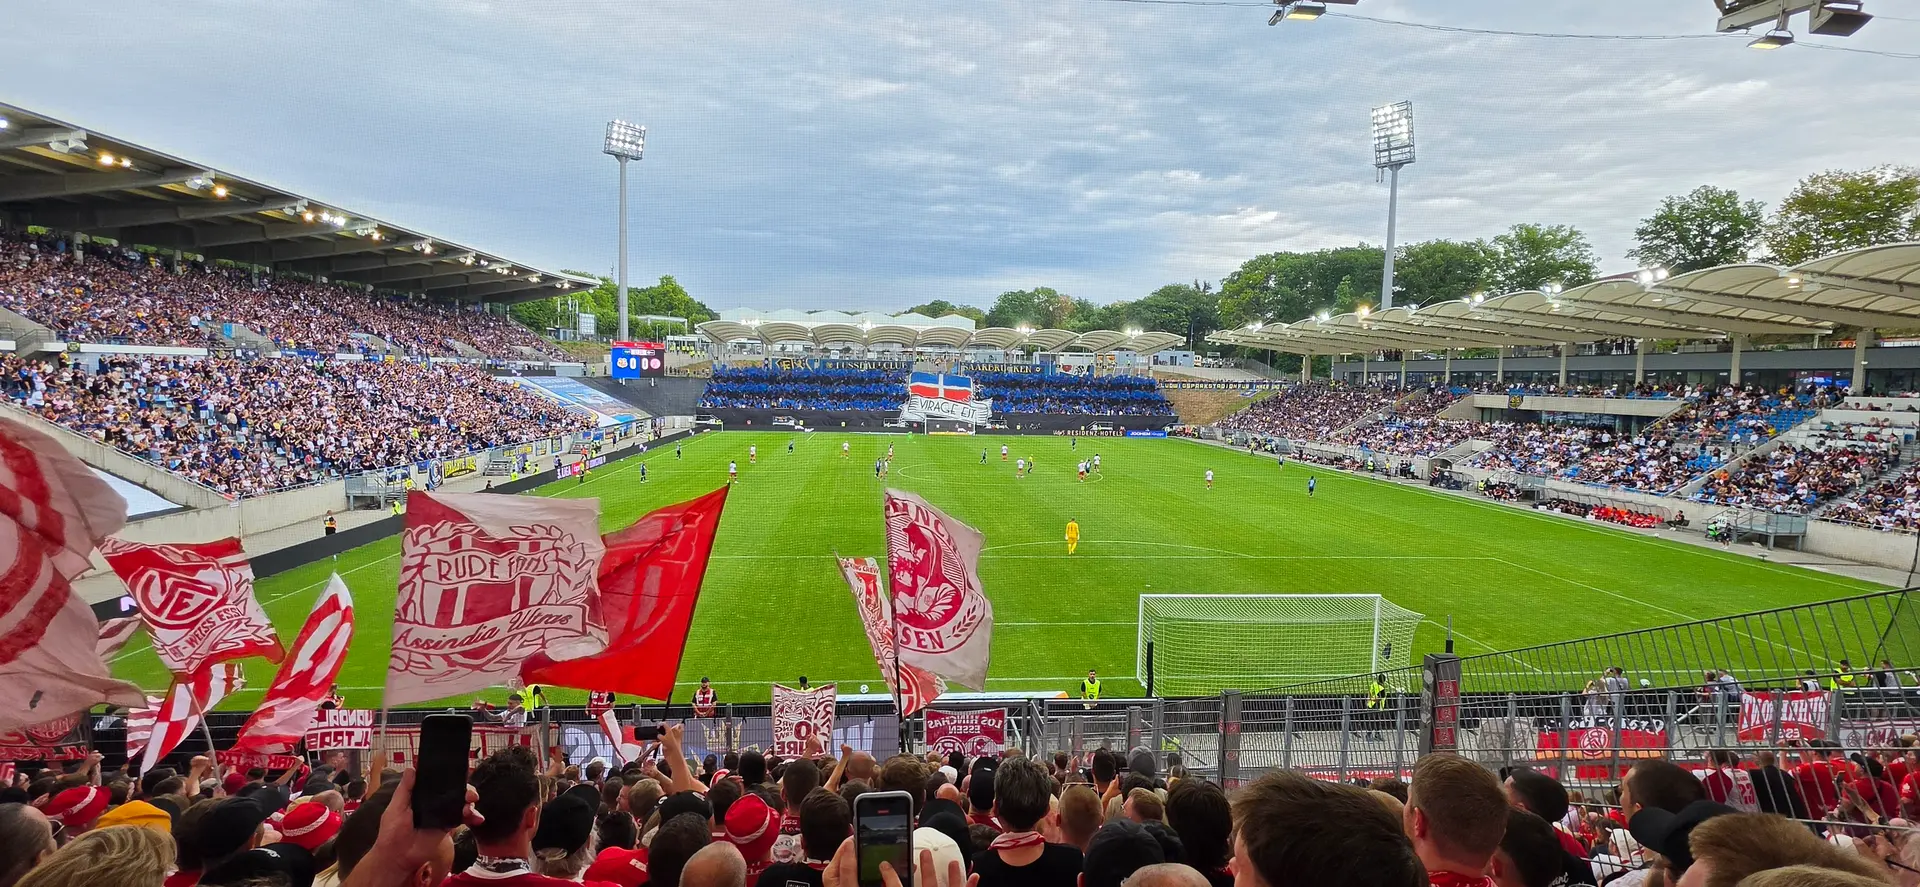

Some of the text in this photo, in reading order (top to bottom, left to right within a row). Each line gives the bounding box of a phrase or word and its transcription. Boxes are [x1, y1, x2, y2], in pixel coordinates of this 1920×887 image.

[920, 399, 959, 415] VIRAGE
[437, 552, 550, 581] RUDE FANS
[391, 608, 573, 649] Assindia Ultras
[900, 626, 945, 650] SEN
